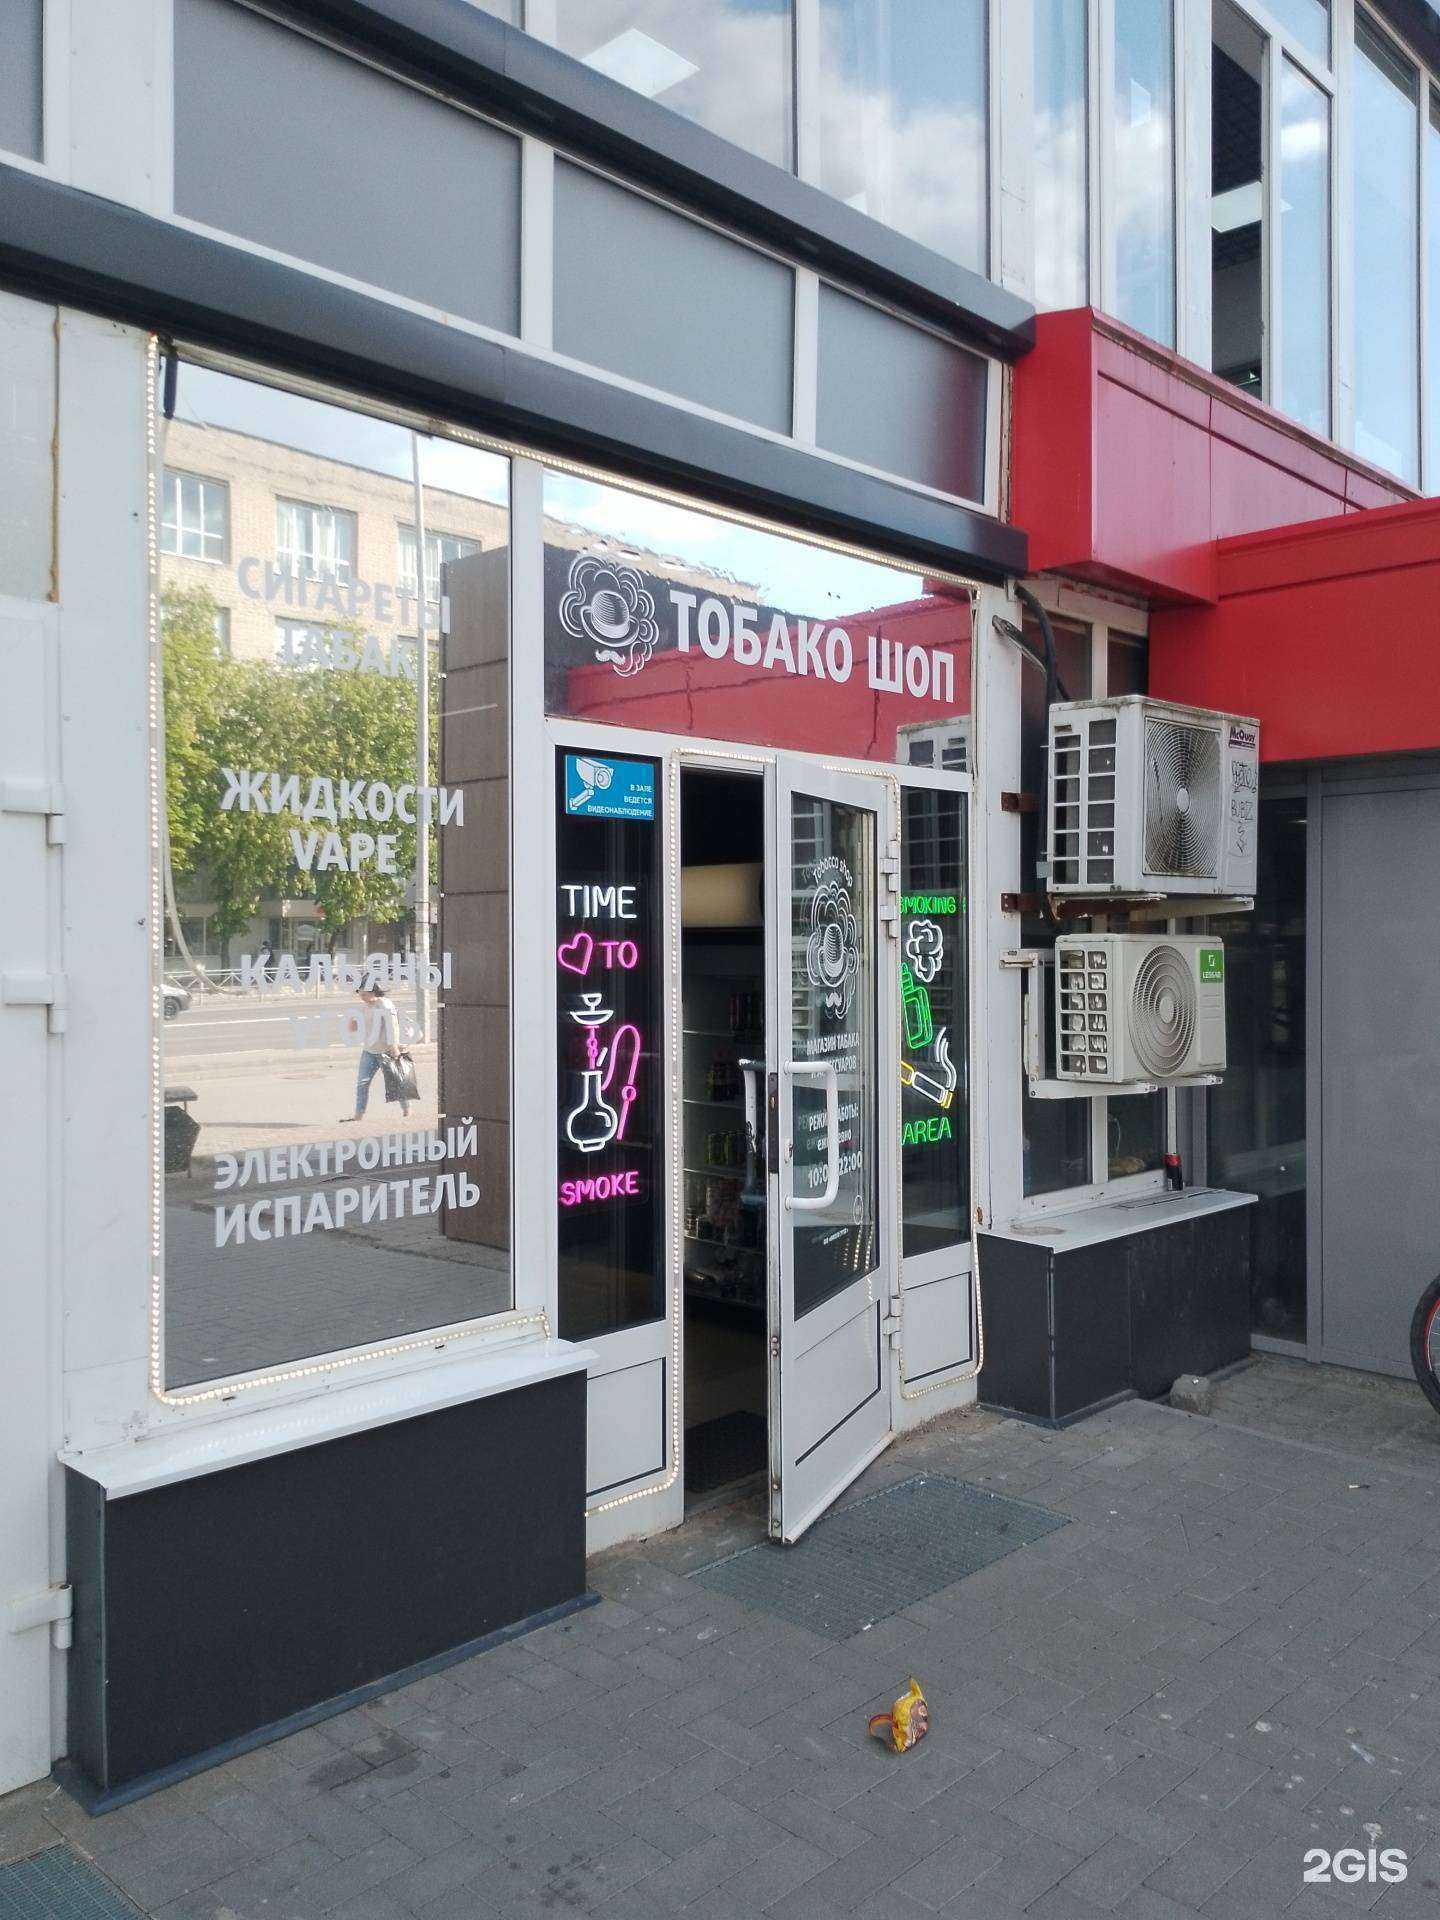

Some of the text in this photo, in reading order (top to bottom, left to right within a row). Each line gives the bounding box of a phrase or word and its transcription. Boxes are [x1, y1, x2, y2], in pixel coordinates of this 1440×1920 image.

[237, 556, 450, 634] СИГАРЕТЫ
[280, 616, 417, 680] ТАБАК
[669, 590, 954, 703] ТОБАКО ШОП
[220, 767, 464, 827] ЖИДКОСТИ
[289, 829, 399, 874] VAPE
[560, 885, 638, 919] TIME
[241, 952, 452, 994] КАЛЬЯНЫ
[598, 941, 638, 969] TO
[214, 1116, 479, 1190] ЭЛЕКТРОННЫЙ
[901, 1117, 951, 1145] AREA
[215, 1172, 481, 1248] ИСПАРИТЕЛЬ
[560, 1170, 640, 1207] SMOKE
